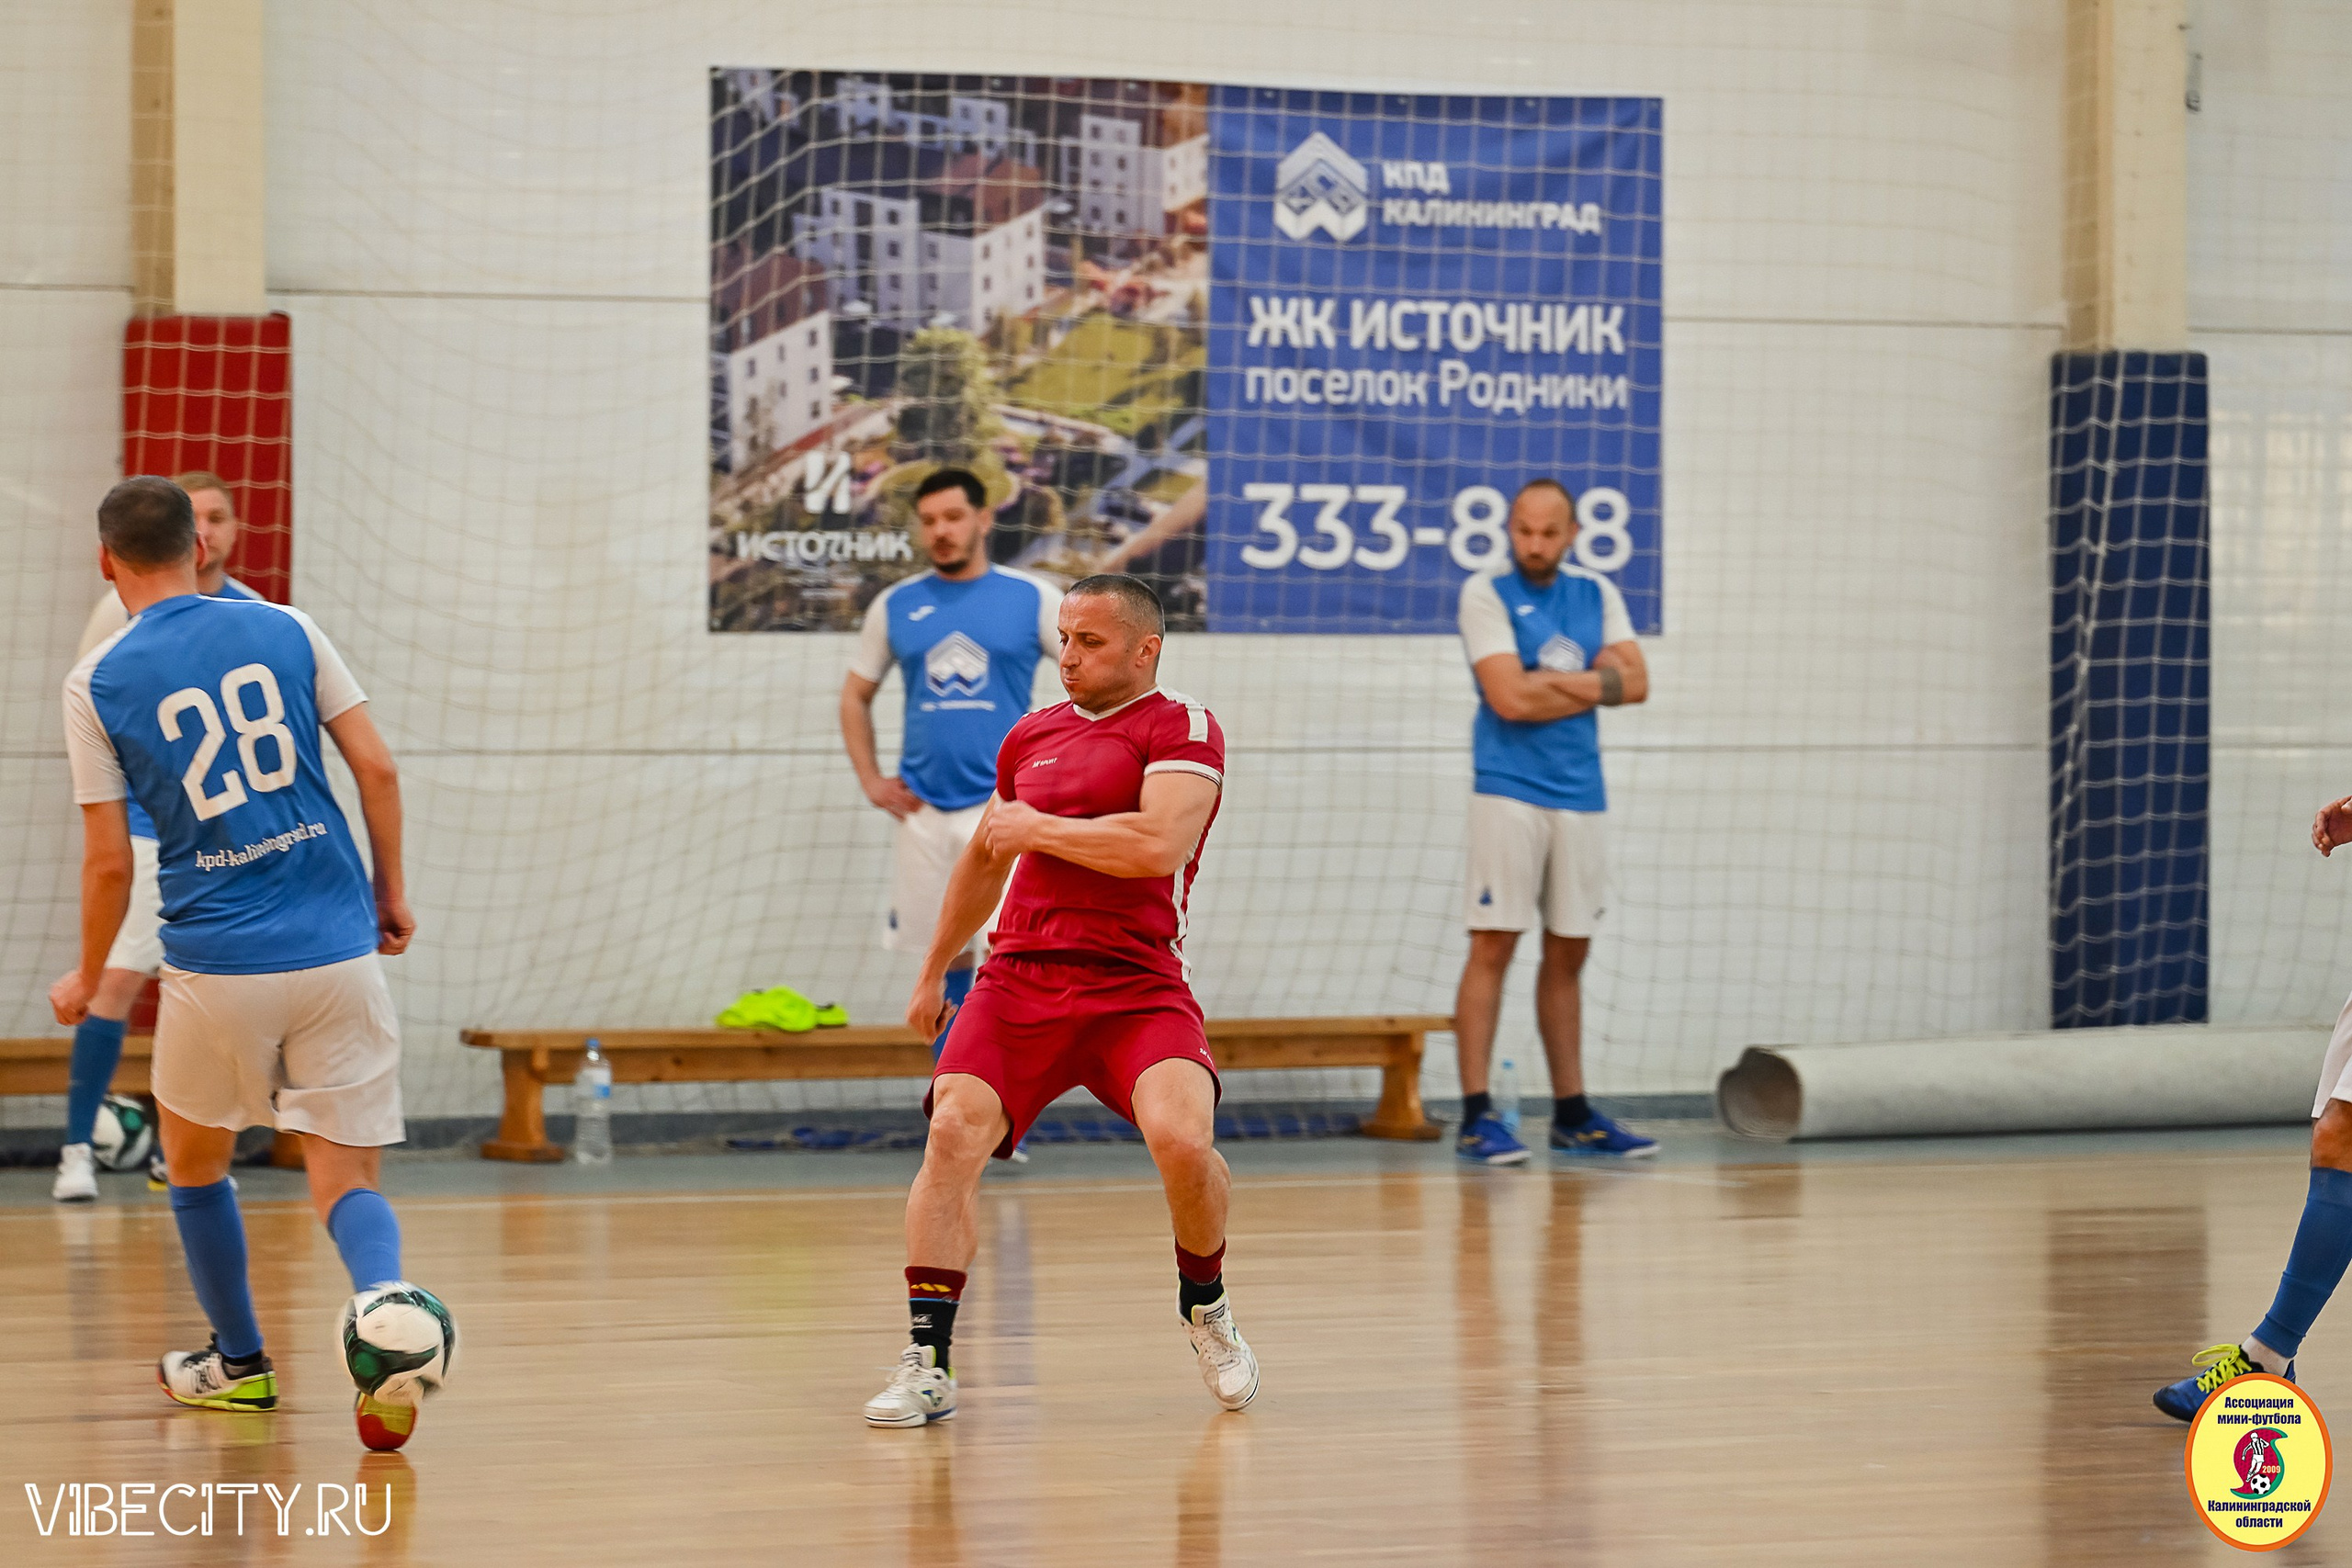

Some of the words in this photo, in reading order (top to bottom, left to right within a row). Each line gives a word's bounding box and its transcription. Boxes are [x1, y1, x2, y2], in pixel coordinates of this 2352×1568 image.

[1382, 160, 1450, 196] КПД
[1382, 199, 1602, 236] КАЛИНИНГРАД
[1247, 296, 1336, 349] ЖК
[1350, 300, 1625, 355] ИСТОЧНИК
[1245, 367, 1429, 407] поселок
[1439, 359, 1628, 413] Родники
[1240, 482, 1634, 573] 333-88
[156, 662, 299, 822] 28
